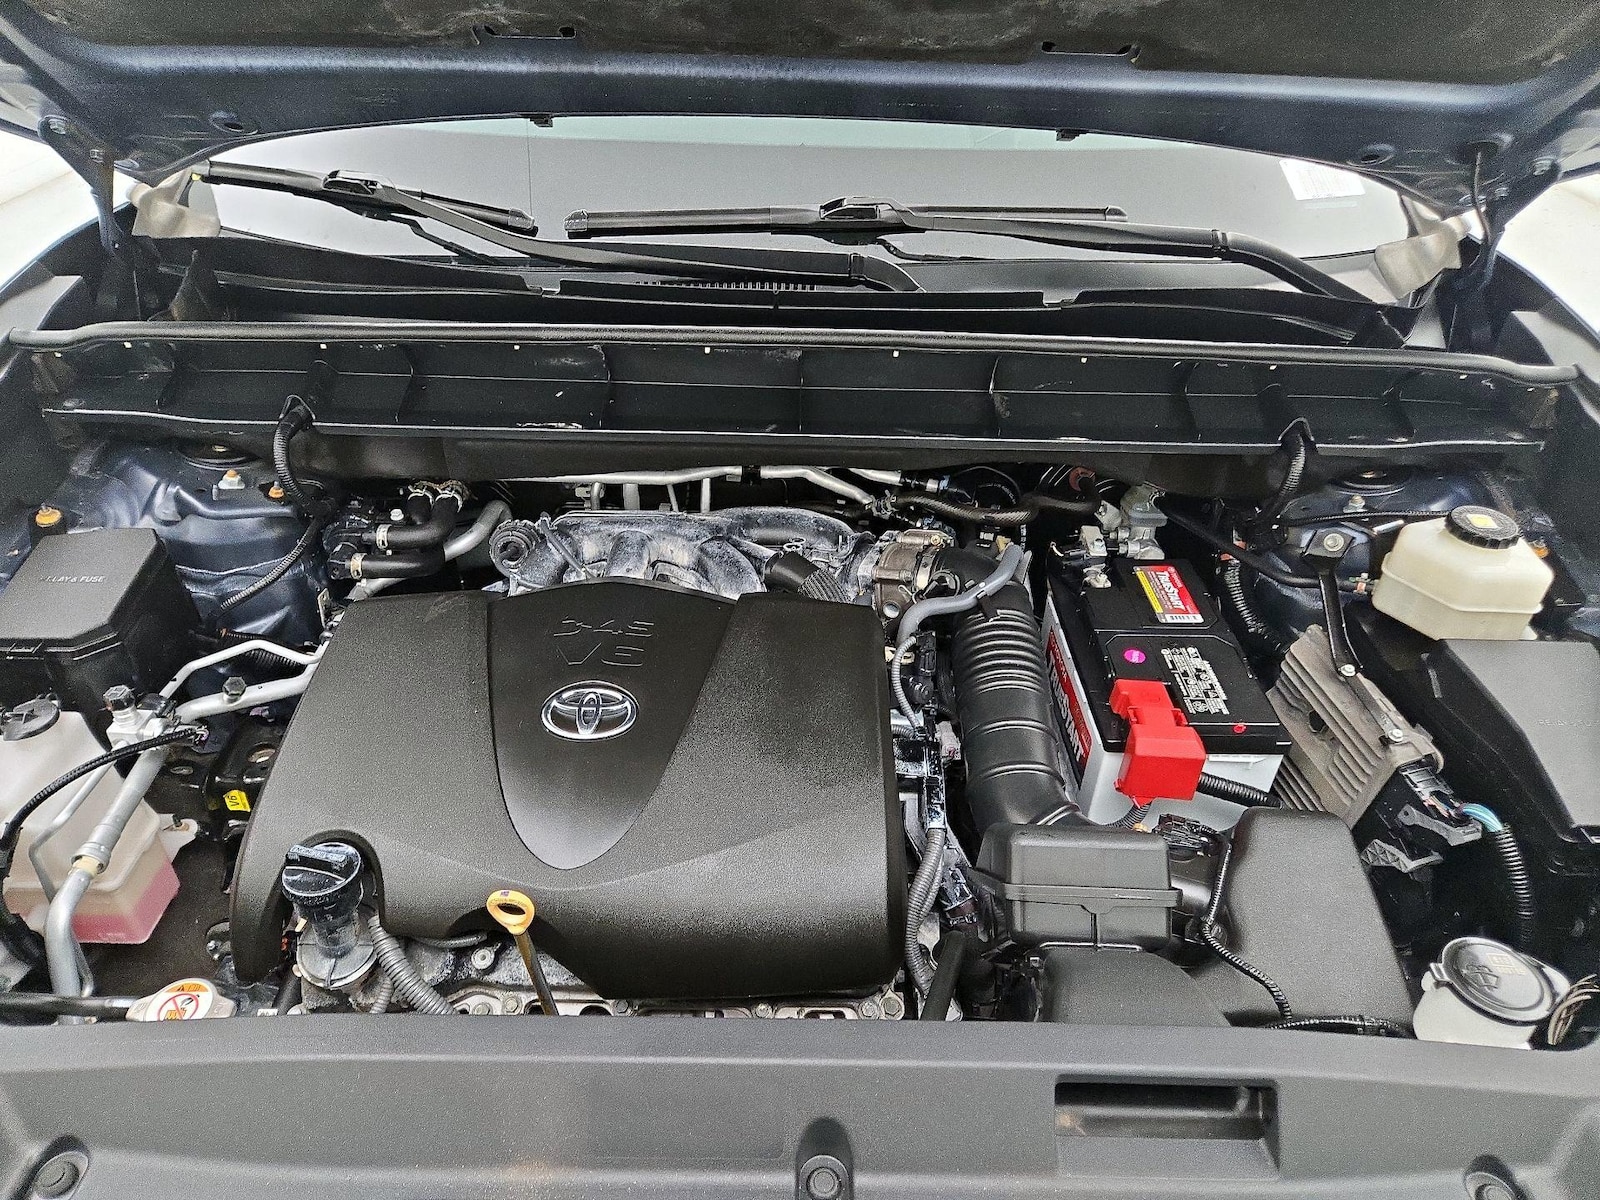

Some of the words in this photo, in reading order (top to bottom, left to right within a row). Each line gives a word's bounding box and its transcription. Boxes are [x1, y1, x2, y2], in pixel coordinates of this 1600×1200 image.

[40, 575, 71, 583] LAY
[79, 575, 105, 583] FUSE
[554, 642, 646, 667] V6
[228, 795, 239, 806] V6
